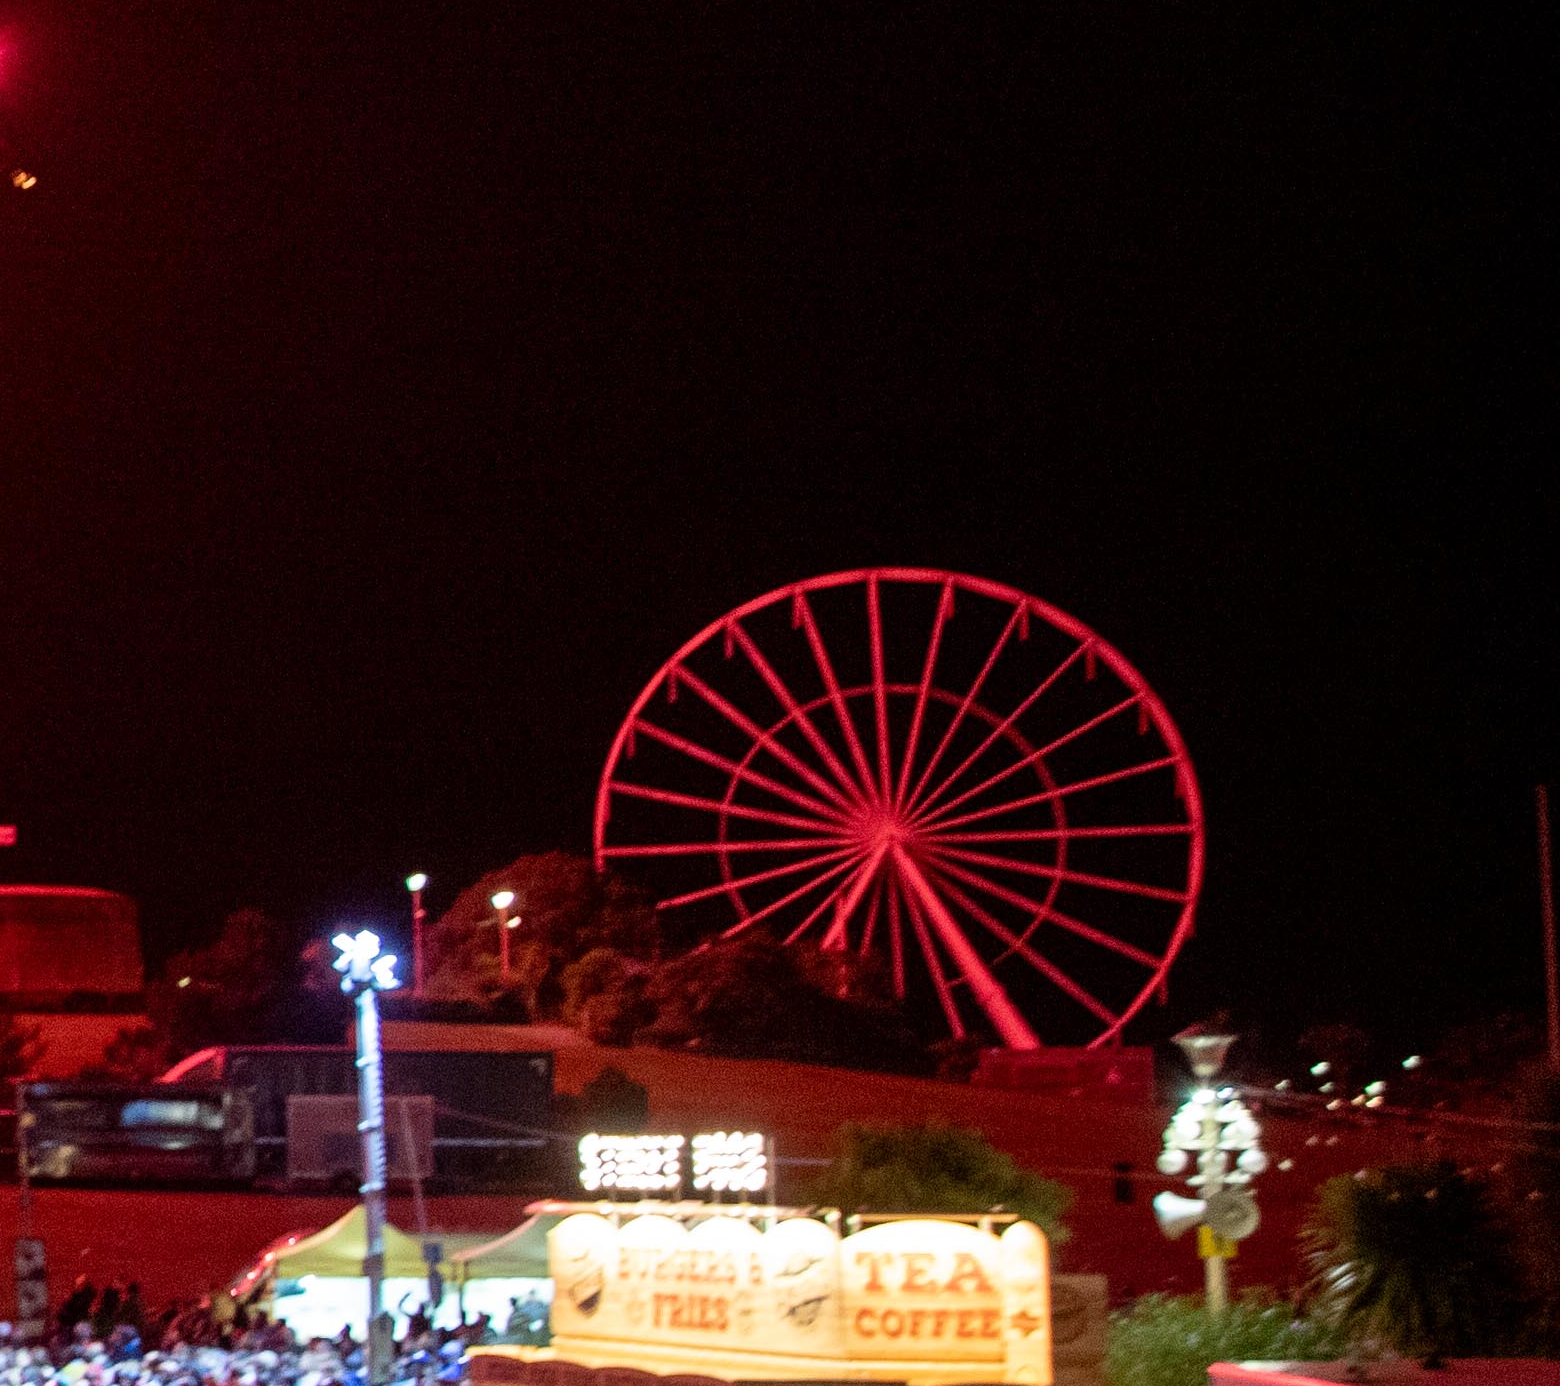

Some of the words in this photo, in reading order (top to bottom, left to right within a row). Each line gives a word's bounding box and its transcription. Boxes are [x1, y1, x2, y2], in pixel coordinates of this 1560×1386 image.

[854, 1251, 995, 1293] TEA
[652, 1292, 729, 1331] FRIES
[854, 1308, 1002, 1339] COFFEE
